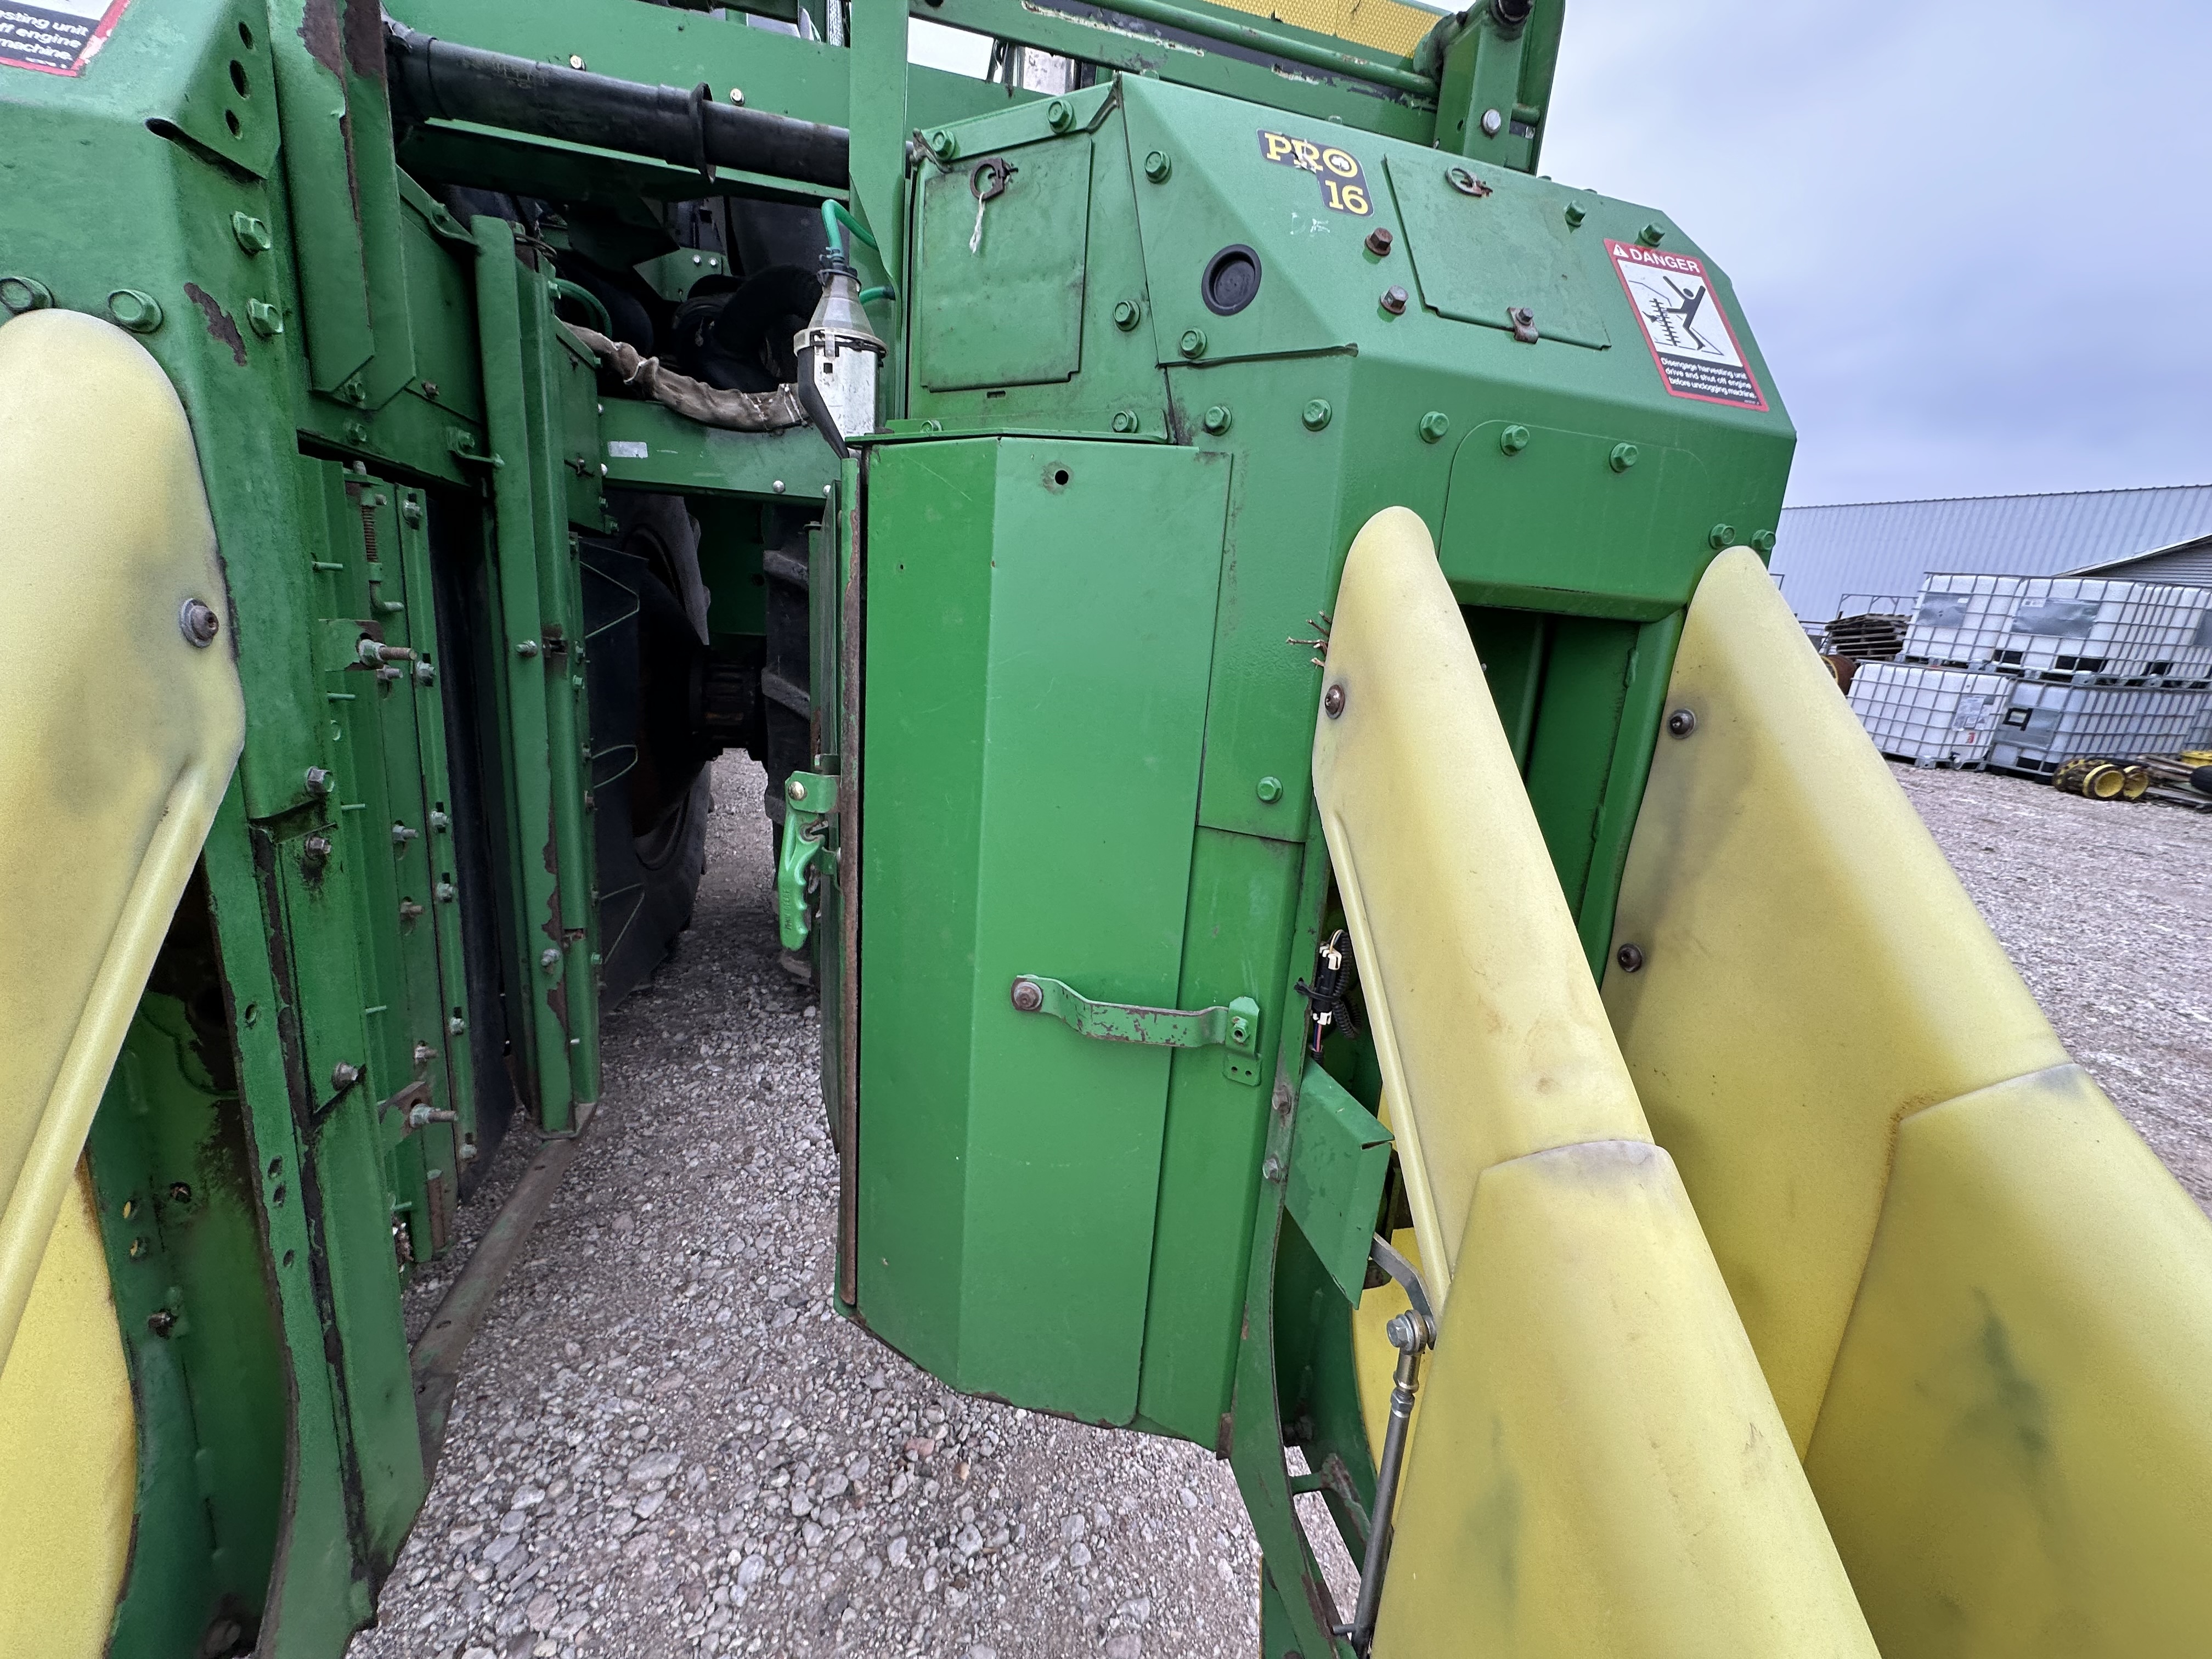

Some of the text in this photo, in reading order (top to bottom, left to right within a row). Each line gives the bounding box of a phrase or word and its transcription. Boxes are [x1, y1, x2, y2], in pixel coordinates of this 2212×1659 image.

[15, 29, 82, 48] engine
[52, 22, 89, 36] unit
[1264, 132, 1358, 178] PRO
[1325, 179, 1368, 215] 16
[1629, 247, 1700, 273] DANGER
[1661, 357, 1697, 371] Disengage
[1697, 364, 1734, 379] harvesting
[1666, 367, 1684, 377] drive
[1685, 371, 1699, 380] and
[1700, 374, 1717, 383] shut
[1728, 380, 1751, 389] engine
[1669, 376, 1691, 387] before
[1691, 382, 1728, 395] unclogging
